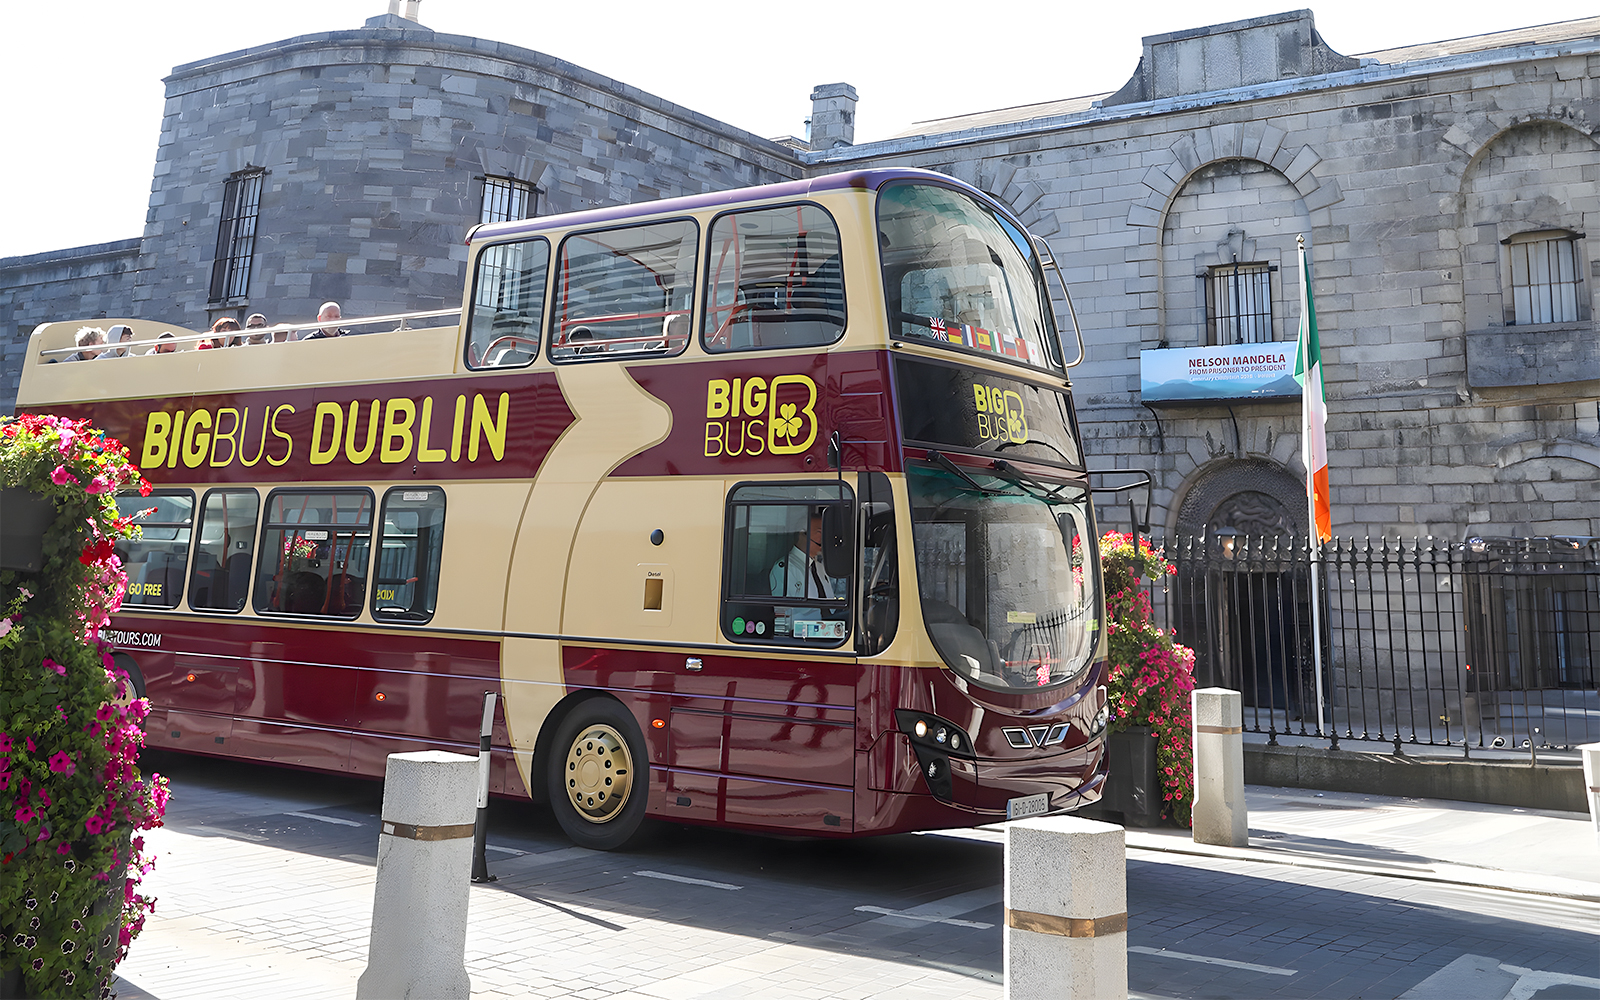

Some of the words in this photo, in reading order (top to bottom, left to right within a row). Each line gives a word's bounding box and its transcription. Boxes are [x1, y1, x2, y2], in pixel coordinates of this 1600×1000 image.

[1188, 357, 1230, 368] NELSON
[1232, 353, 1286, 366] MANDELA
[1189, 367, 1208, 375] FROM
[1208, 366, 1240, 374] PRISONER
[1251, 364, 1286, 372] PRESIDENT
[706, 376, 768, 419] BIG
[972, 383, 1004, 412] BIG
[309, 391, 510, 465] DUBLIN
[704, 419, 765, 457] BUS
[977, 413, 1008, 442] BUS
[128, 582, 142, 595] GO
[143, 582, 163, 597] FREE
